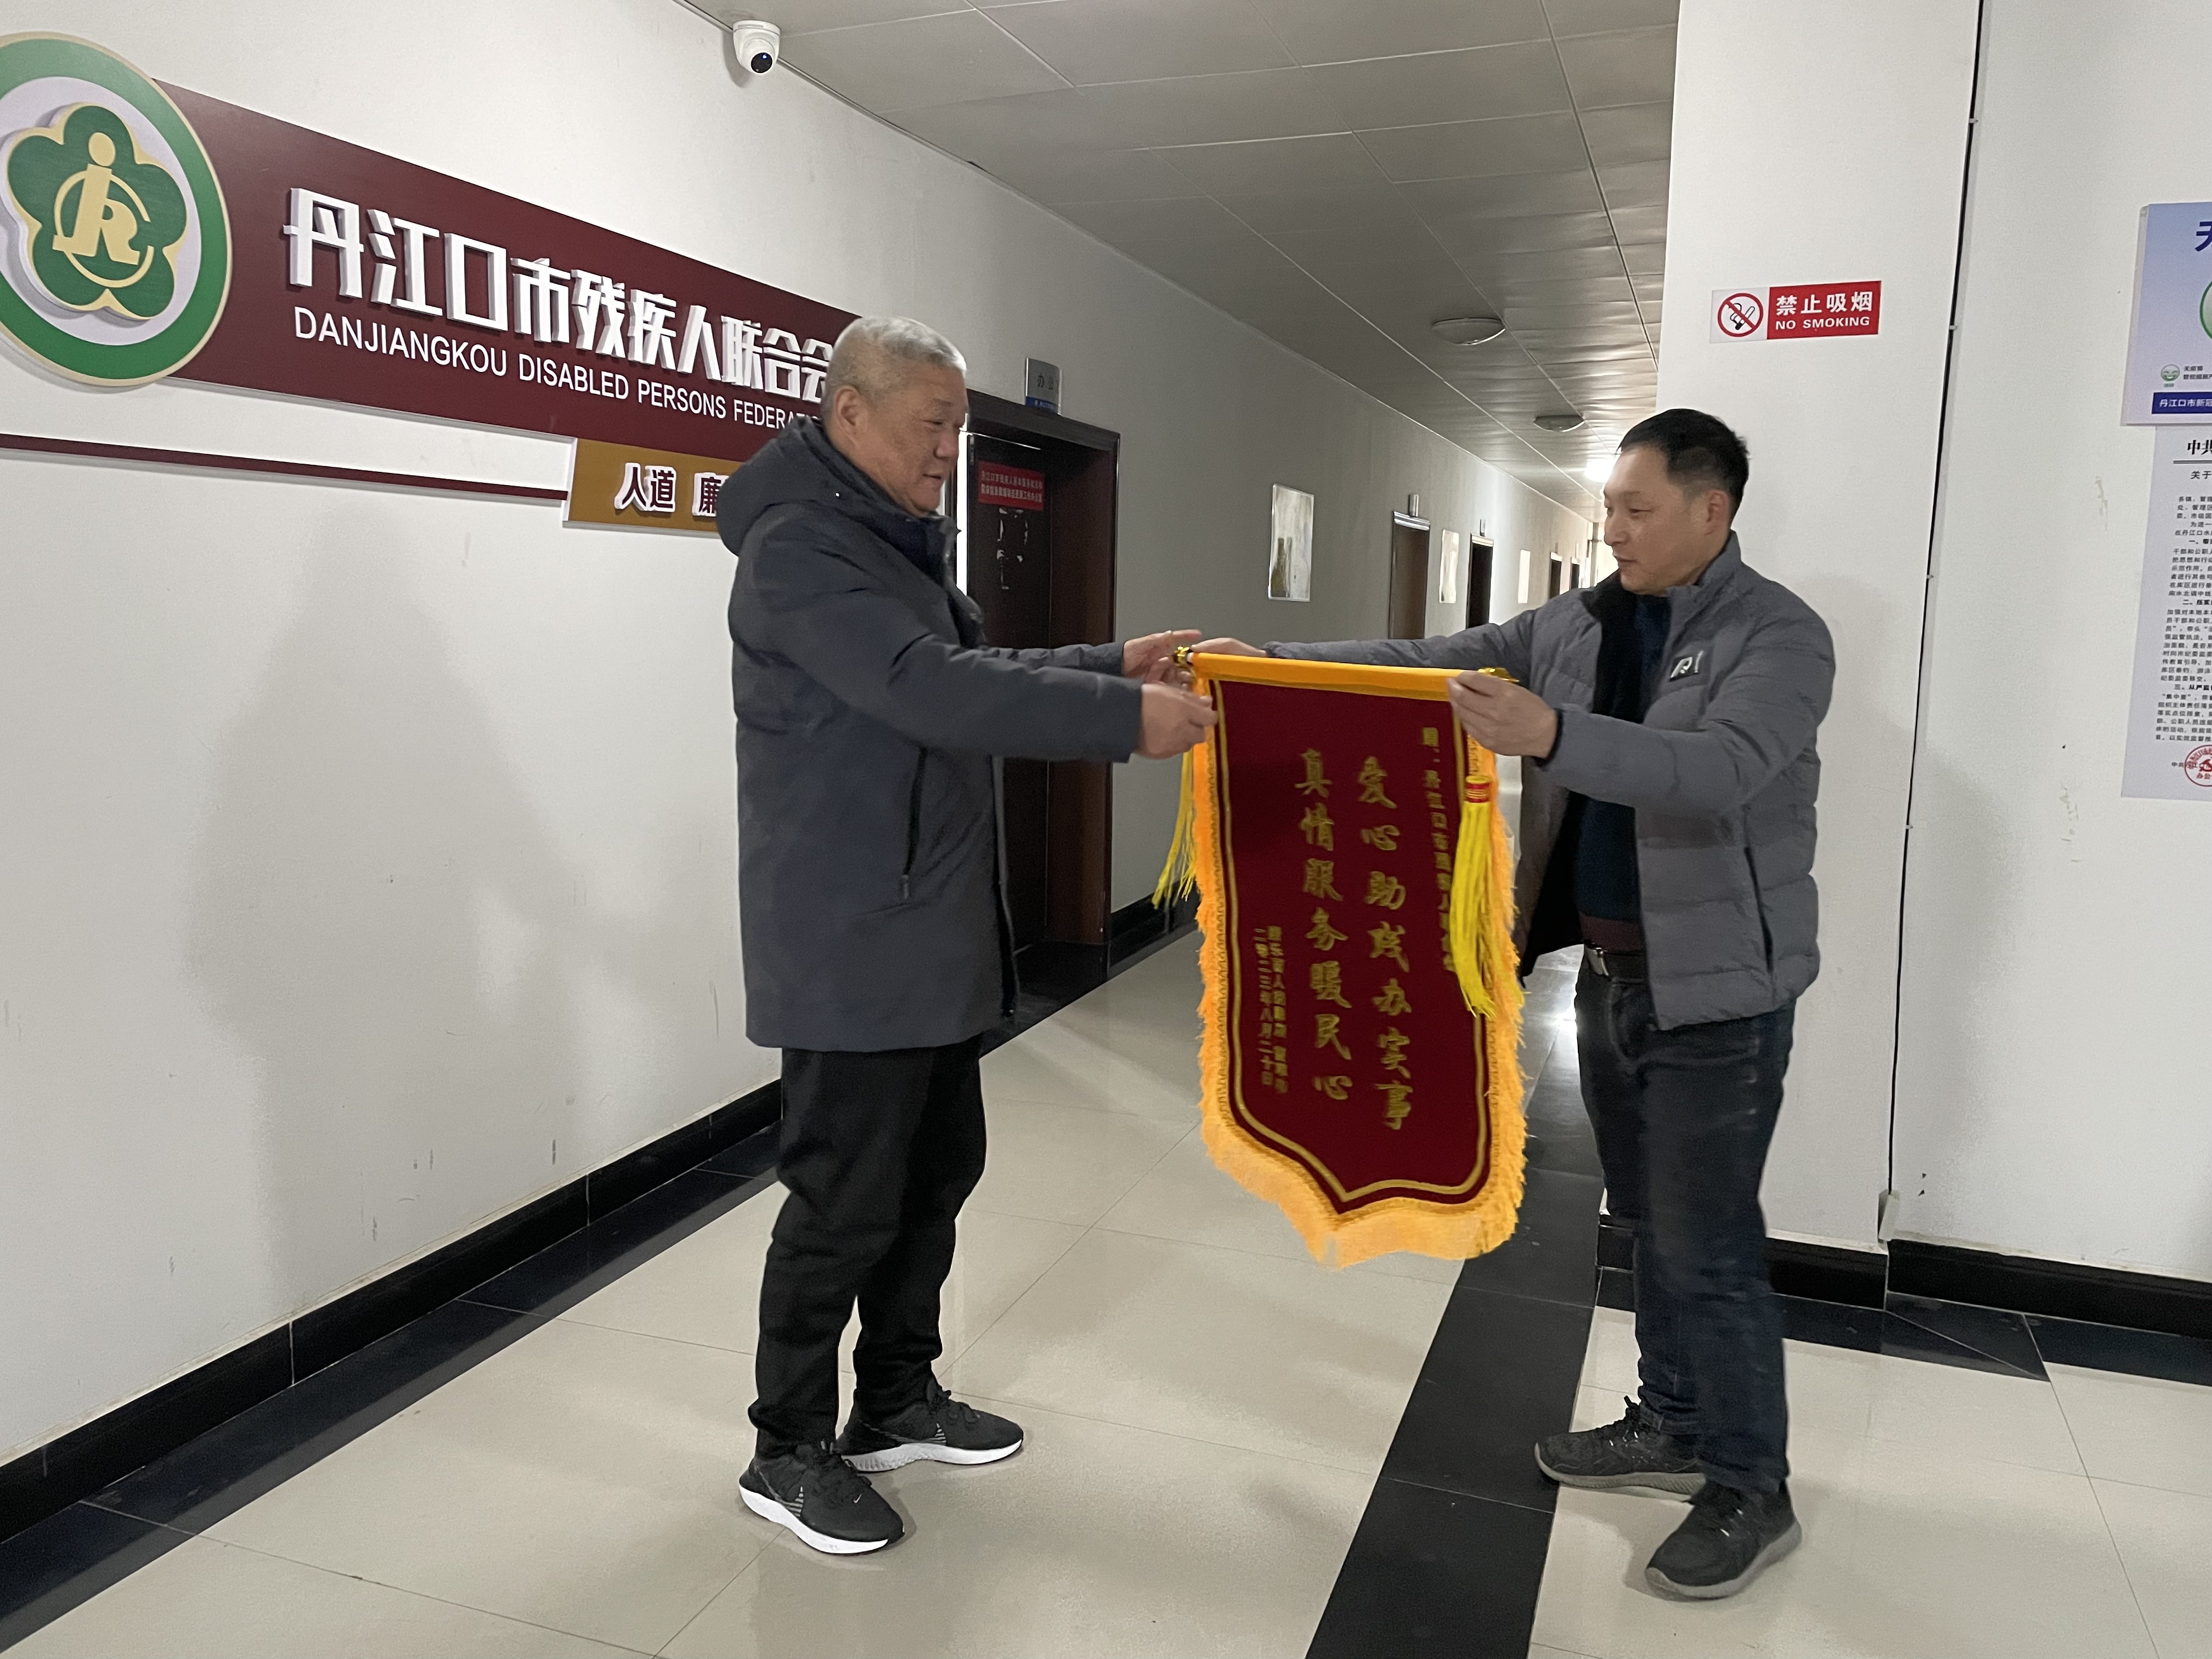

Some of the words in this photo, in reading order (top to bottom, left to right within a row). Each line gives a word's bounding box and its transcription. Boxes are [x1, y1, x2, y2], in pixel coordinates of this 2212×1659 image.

[283, 188, 833, 403] 丹江口市残疾人联合会
[1776, 291, 1873, 316] 禁止吸烟
[1775, 320, 1796, 330] NO
[1803, 317, 1870, 329] SMOKING
[295, 306, 506, 376] DANJIANGKOU
[519, 354, 629, 399] DISABLED
[637, 379, 726, 419] PERSONS
[734, 399, 820, 430] FEDERA
[614, 462, 676, 512] 人道
[2191, 471, 2212, 479] 关于
[1294, 748, 1353, 1101] 真情服务暖民心
